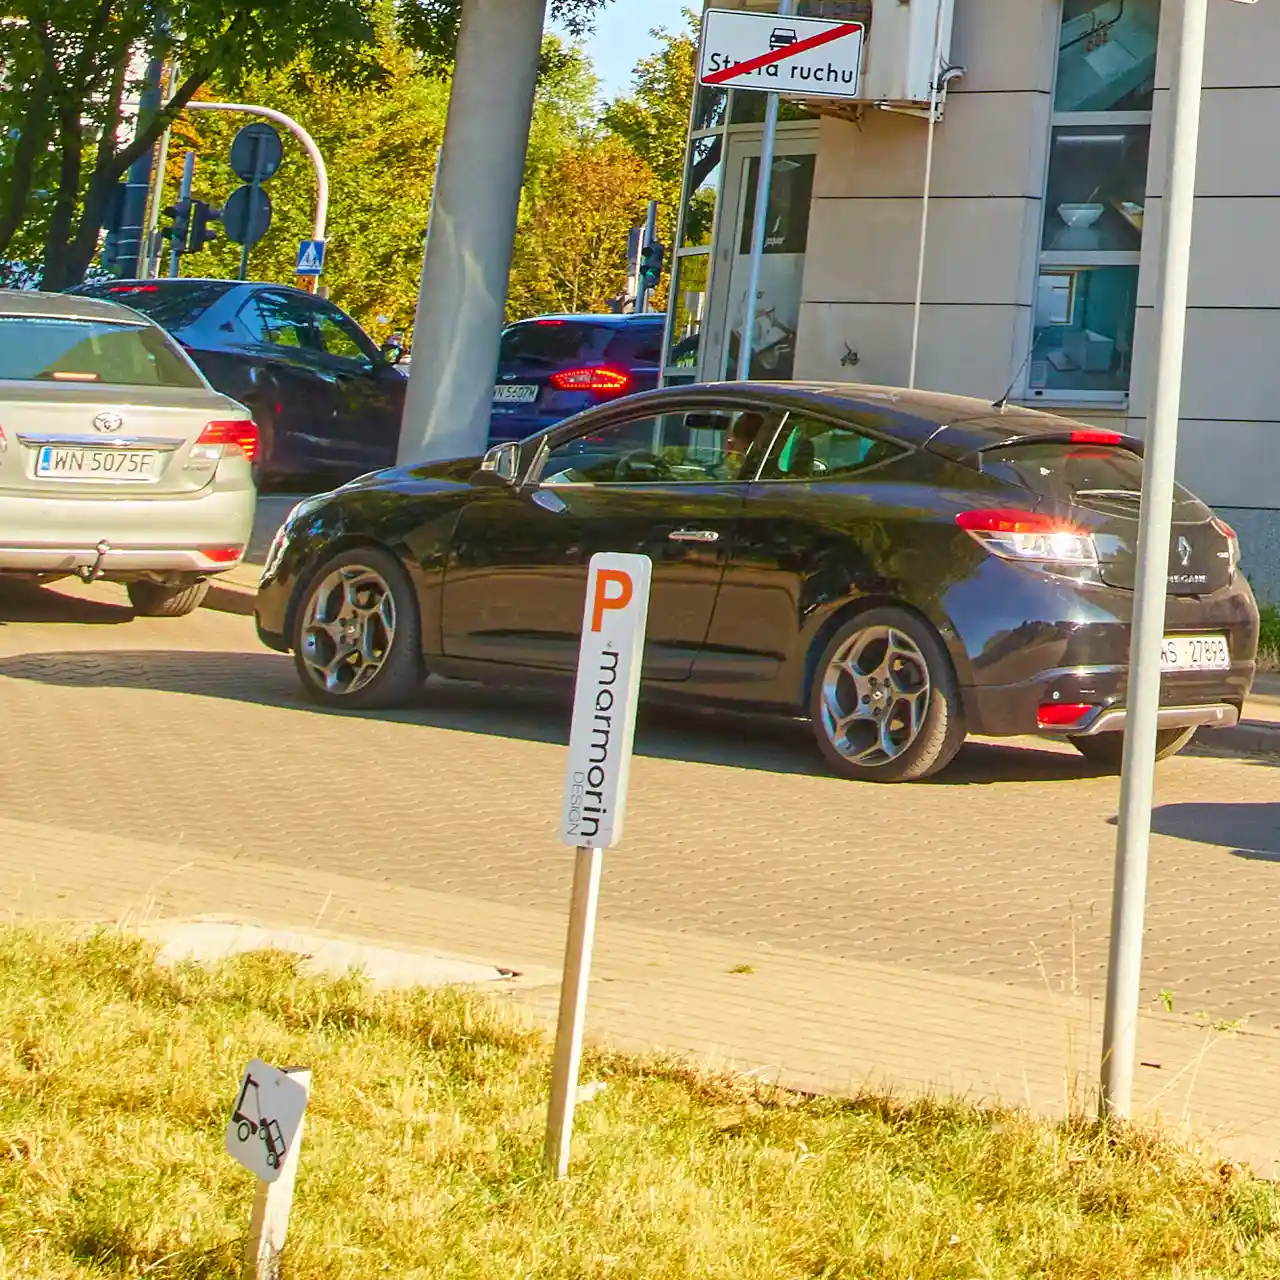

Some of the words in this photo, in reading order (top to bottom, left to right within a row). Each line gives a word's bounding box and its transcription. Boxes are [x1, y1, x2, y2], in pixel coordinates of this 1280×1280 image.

[790, 63, 853, 83] ruchu
[54, 451, 84, 471] WN
[90, 452, 154, 473] 5075F
[591, 569, 633, 632] P
[580, 650, 620, 837] marmorin
[567, 771, 585, 836] DESIGN
